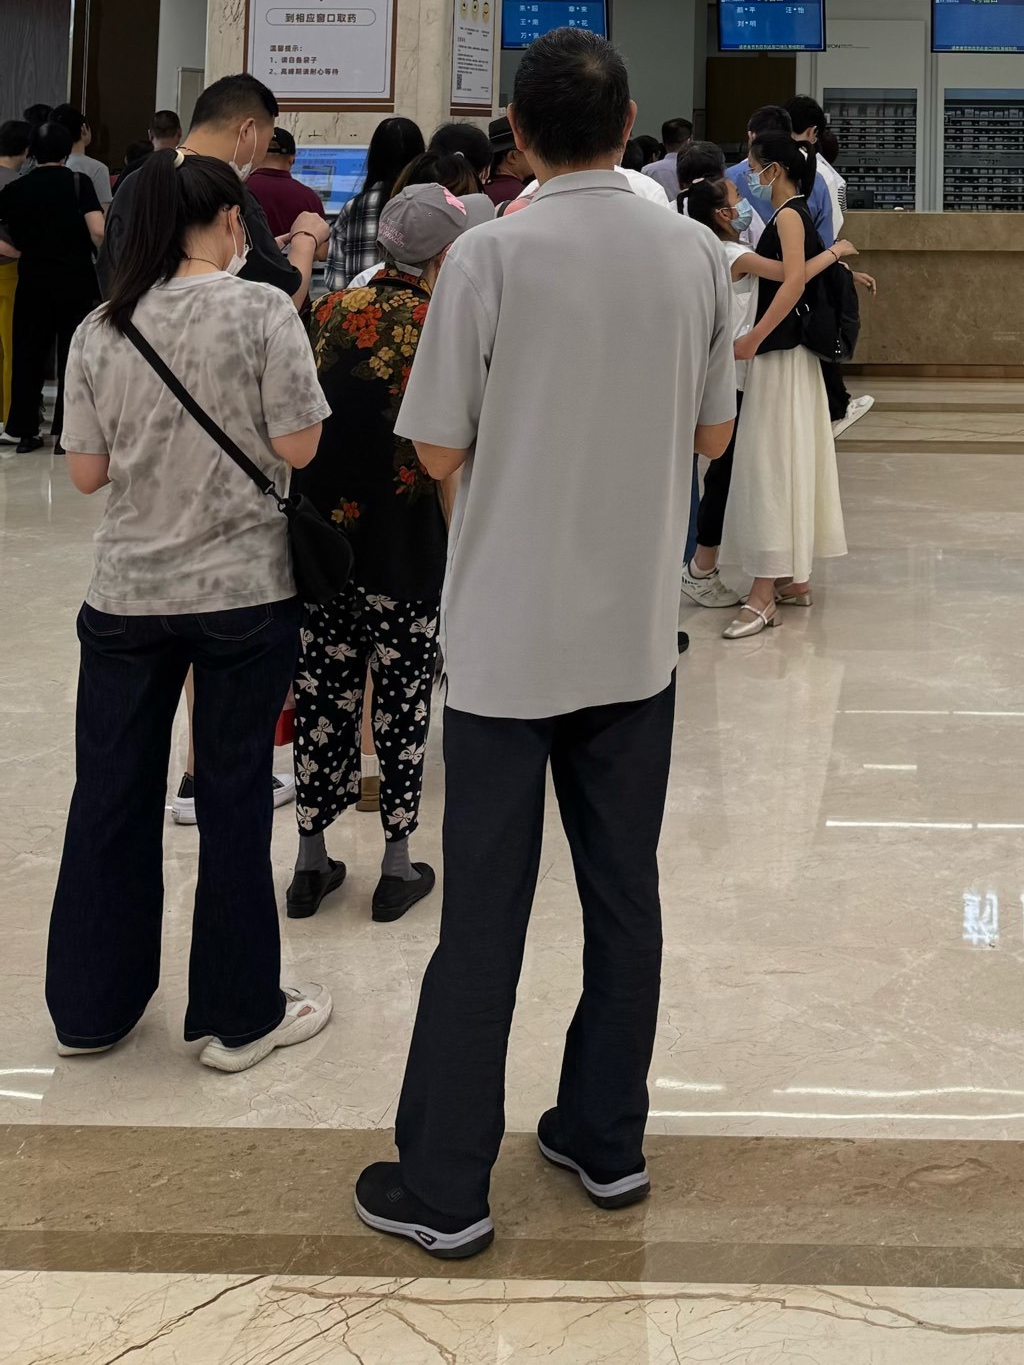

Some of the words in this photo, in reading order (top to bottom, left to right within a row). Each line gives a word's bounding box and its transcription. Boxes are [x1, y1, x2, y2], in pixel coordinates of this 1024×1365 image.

[285, 13, 357, 23] 到相应窗口取药
